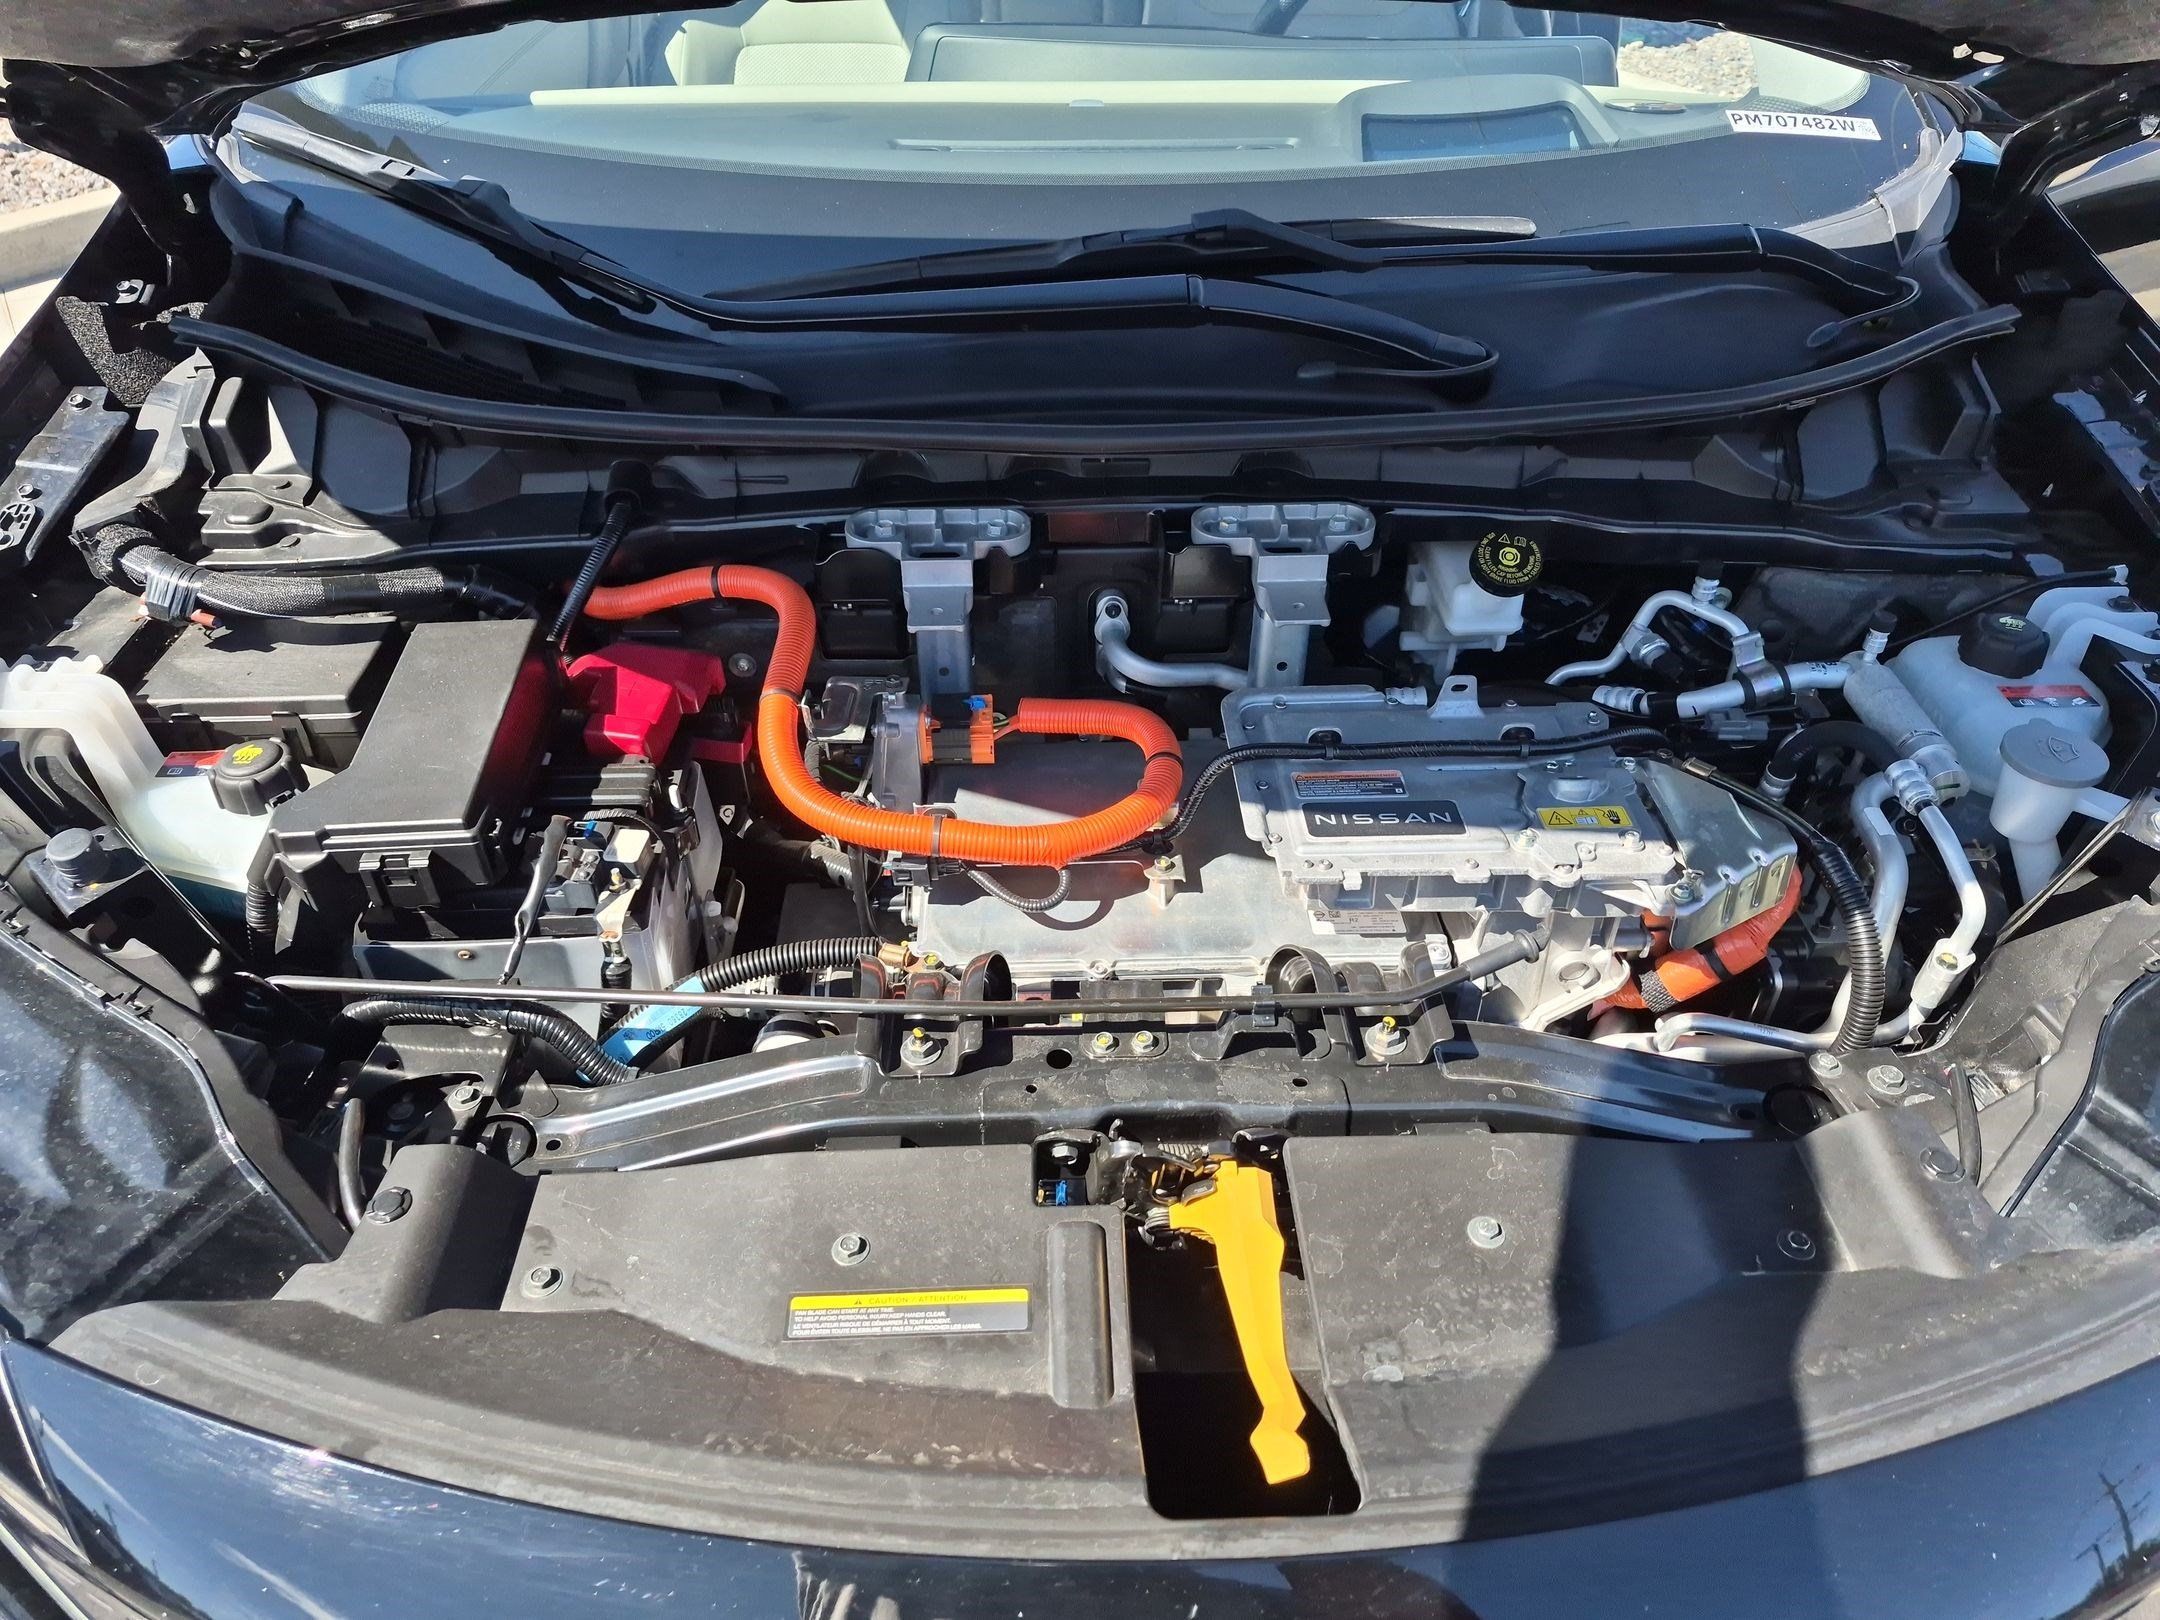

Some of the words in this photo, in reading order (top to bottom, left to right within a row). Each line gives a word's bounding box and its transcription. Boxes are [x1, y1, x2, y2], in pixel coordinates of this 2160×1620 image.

[1731, 113, 1856, 132] PM707482W
[1314, 812, 1452, 825] NISSAN
[868, 1296, 908, 1304] CAUTION
[918, 1294, 967, 1302] ATTENTION
